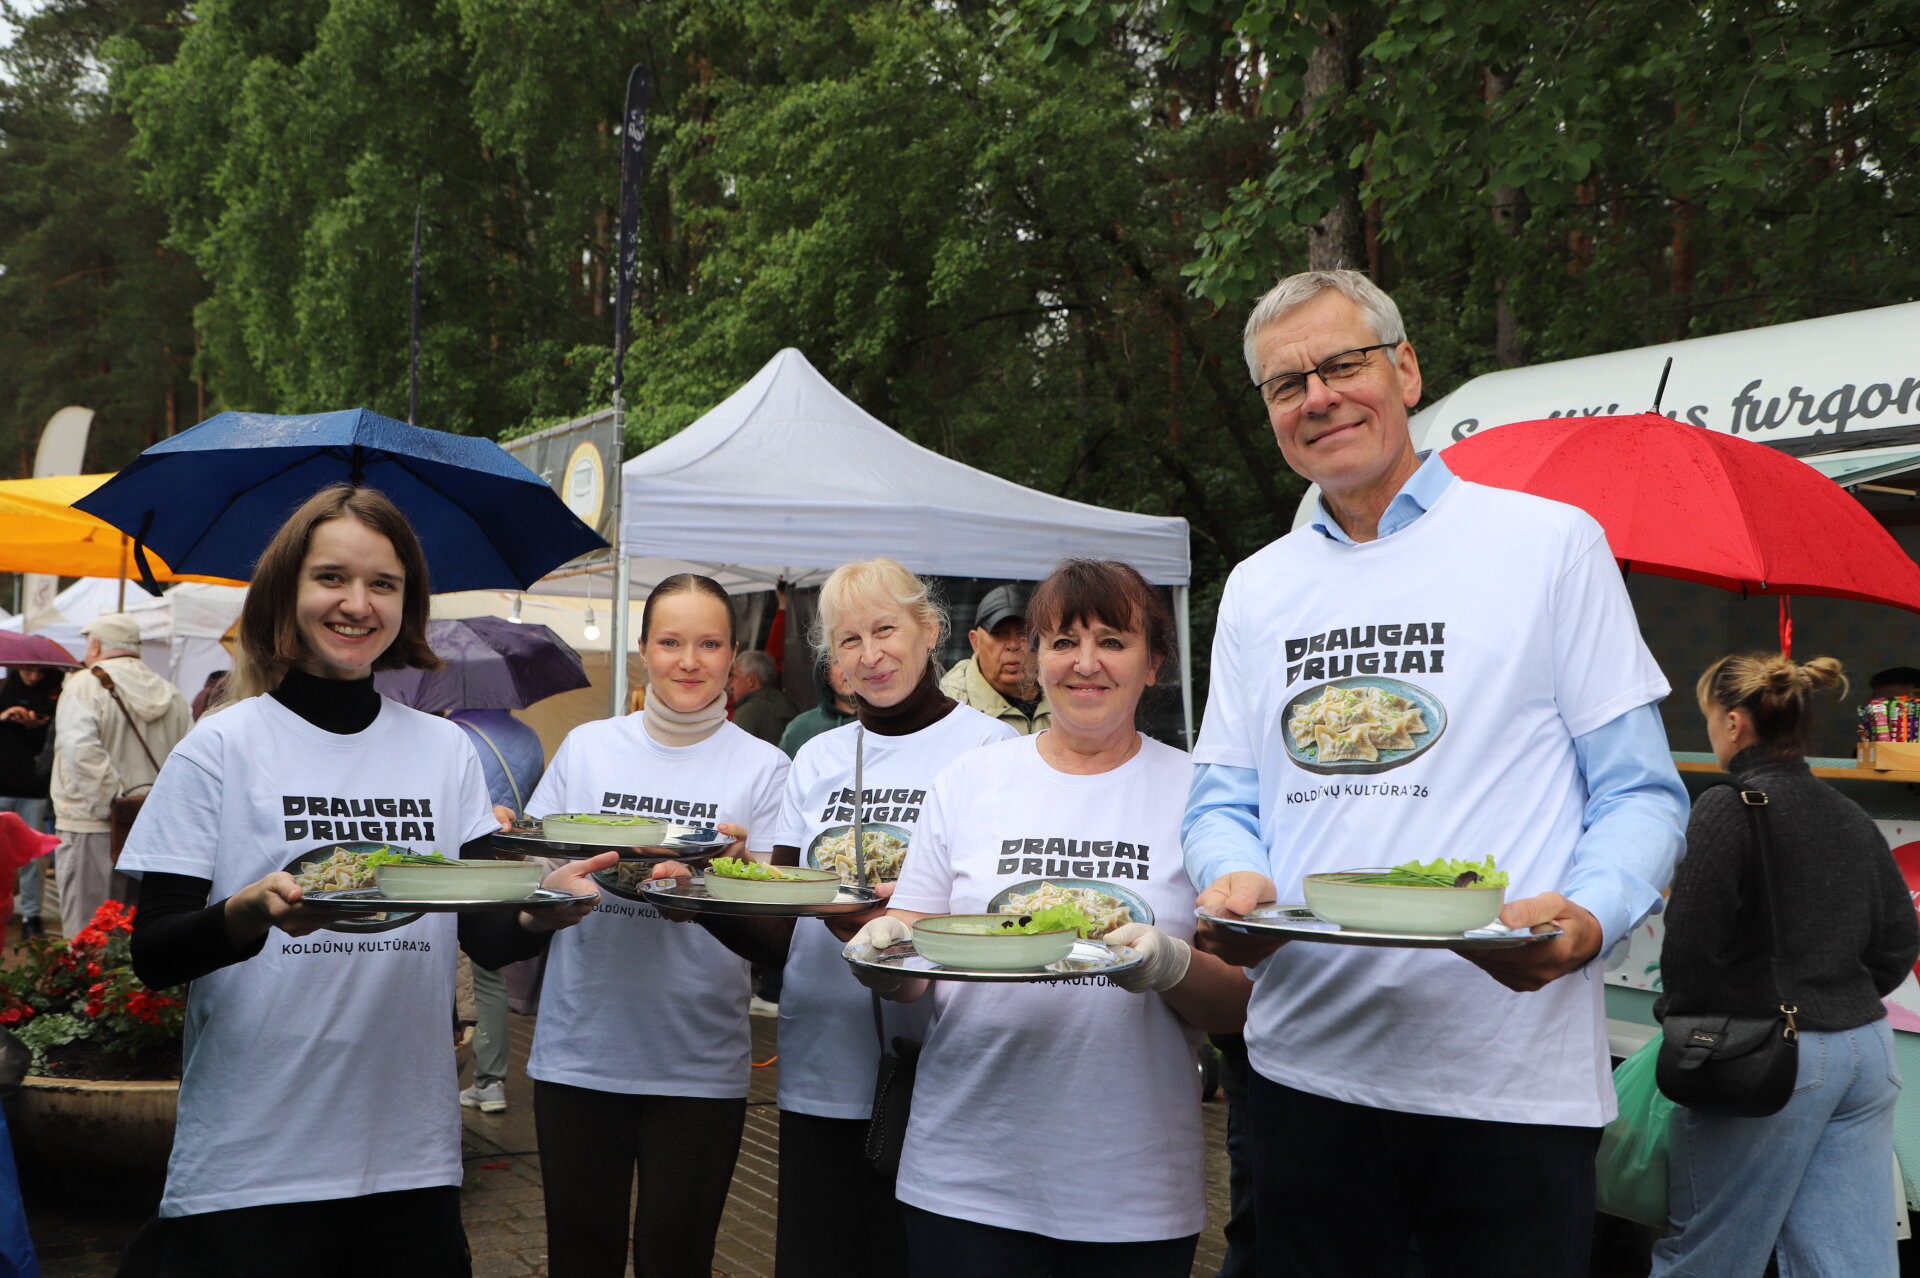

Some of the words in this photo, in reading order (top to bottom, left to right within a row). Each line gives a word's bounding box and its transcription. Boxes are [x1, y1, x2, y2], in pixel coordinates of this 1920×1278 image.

[1285, 622, 1446, 663] DRAUGAI
[1286, 650, 1444, 688] DRUGIAI
[282, 795, 433, 817] DRAUGAI
[602, 791, 718, 819] DRAUGAI
[828, 788, 927, 805] DRAUGA
[820, 805, 921, 823] DRUGIA
[284, 820, 436, 842] DRUGIAI
[1000, 838, 1150, 862] DRAUGAI
[997, 858, 1150, 880] DRUGIAI
[591, 903, 635, 917] OLDŪNŲ
[282, 940, 354, 955] KOLDŪNŲ
